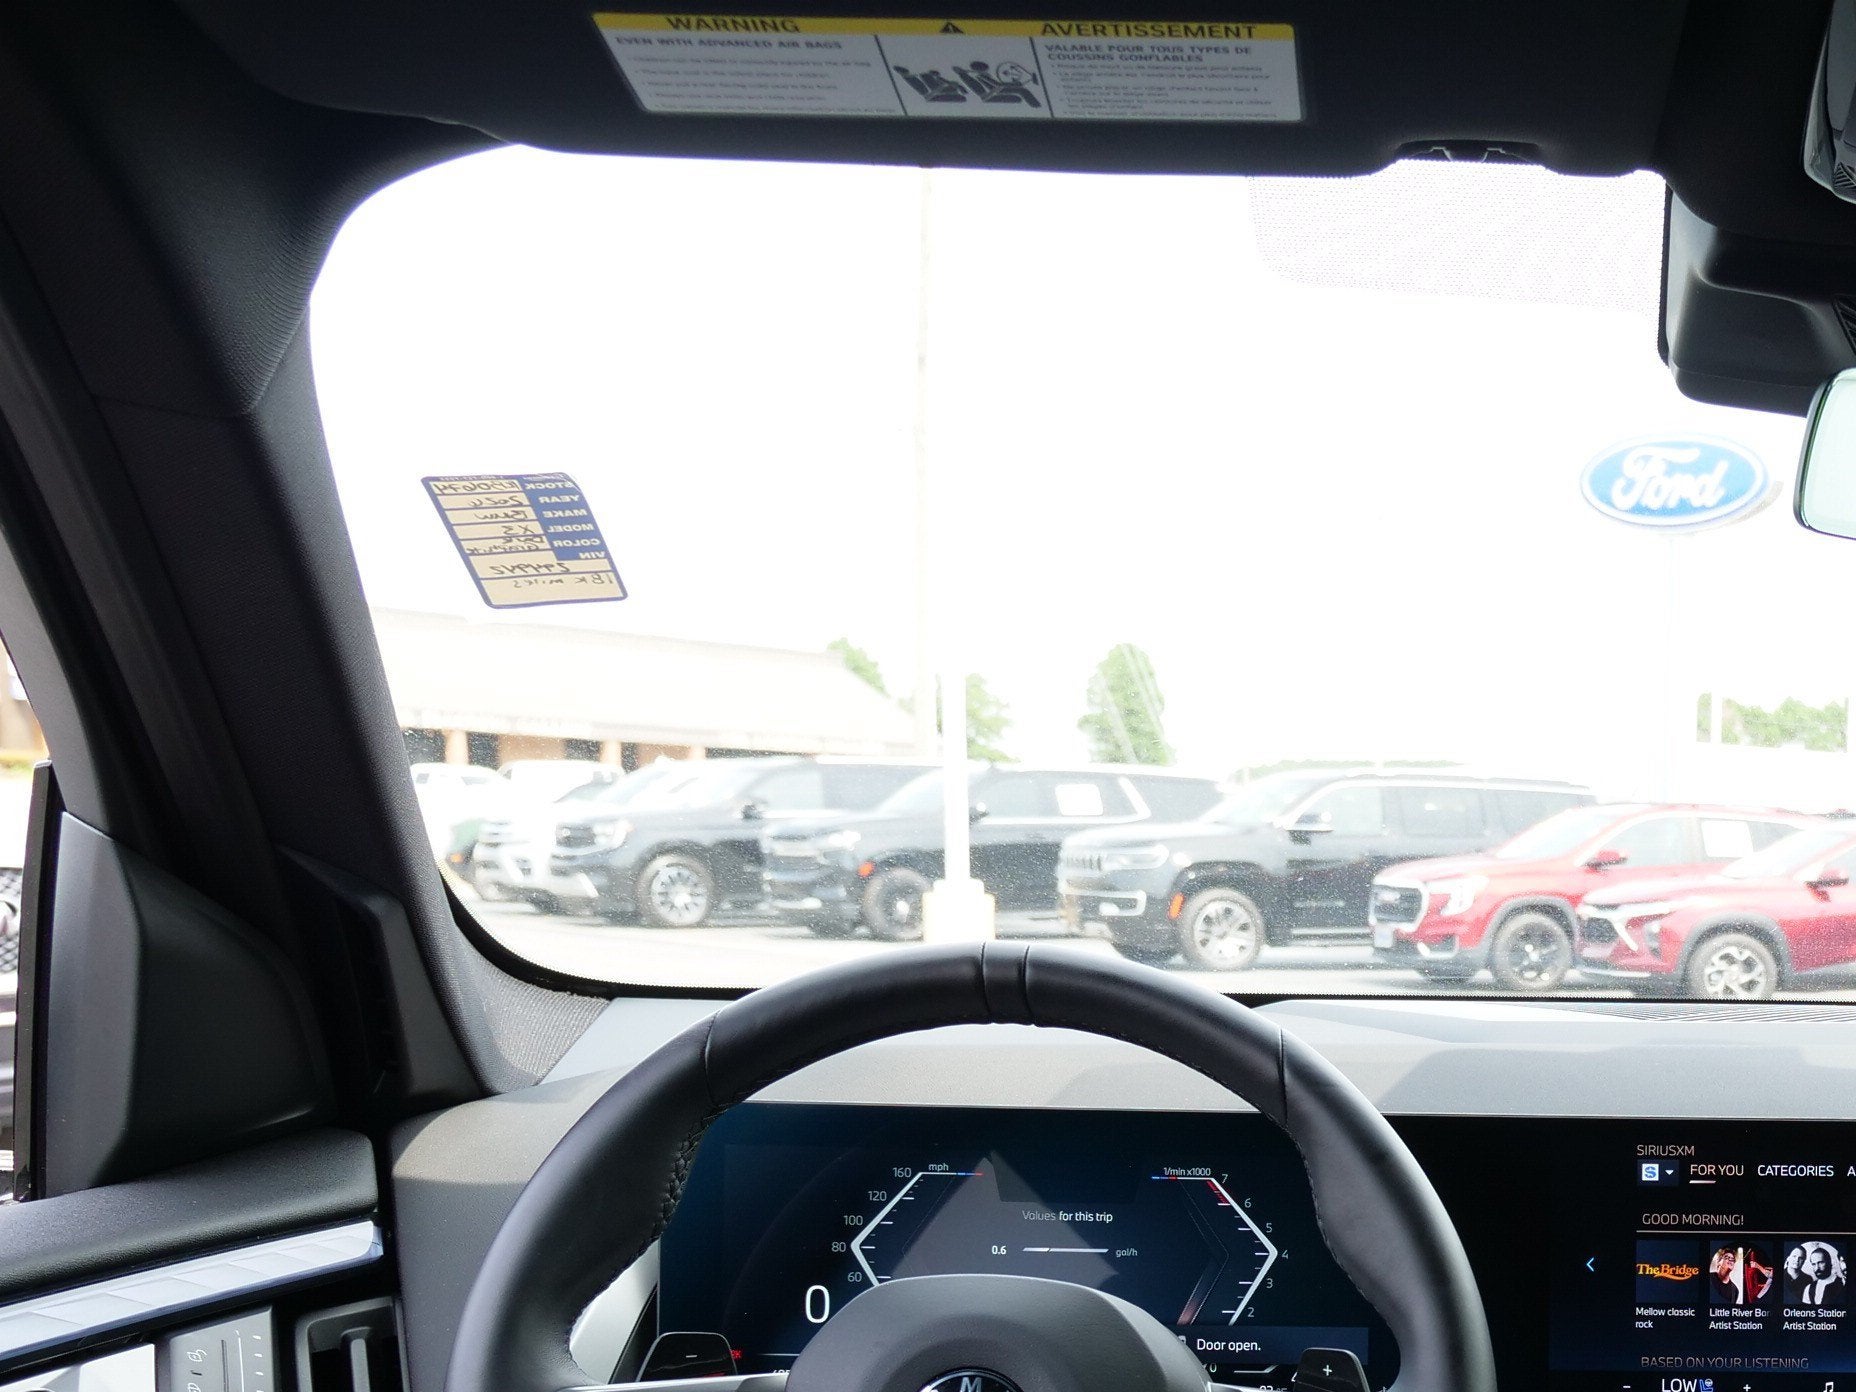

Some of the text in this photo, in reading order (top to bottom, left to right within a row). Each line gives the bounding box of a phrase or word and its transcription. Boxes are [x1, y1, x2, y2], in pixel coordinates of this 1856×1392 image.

[666, 17, 801, 33] WARNING
[1040, 22, 1257, 40] AVERTISSEMENT
[615, 36, 842, 49] EVEN WITH ADVANCED AIR BAGS
[1044, 44, 1251, 55] VALABLE POUR TOUS TYPES DE
[1048, 53, 1203, 62] COUSSINS GONFLABLES
[1610, 446, 1729, 511] Ford
[1637, 1144, 1695, 1156] SIRIUSXM
[892, 1167, 911, 1177] 160
[928, 1163, 949, 1173] mph
[1163, 1167, 1211, 1177] 1/min x1000
[1690, 1164, 1715, 1175] FOR
[1718, 1165, 1744, 1176] YOU
[1757, 1165, 1834, 1177] CATEGORIES
[1221, 1174, 1228, 1184] 7
[868, 1191, 887, 1201] 120
[1244, 1198, 1251, 1208] 6
[844, 1215, 863, 1226] 100
[1022, 1210, 1113, 1224] Values for this trip
[1642, 1213, 1744, 1226] GOOD MORNING!
[1266, 1223, 1273, 1233] 5
[831, 1242, 846, 1252] 80
[991, 1245, 1007, 1255] 0.6
[1115, 1248, 1138, 1257] gal/h
[1281, 1250, 1289, 1260] 4
[847, 1272, 862, 1282] 60
[1266, 1278, 1273, 1289] 3
[805, 1284, 830, 1323] 0
[1247, 1307, 1255, 1317] 2
[1635, 1307, 1695, 1317] Mellow classic
[1709, 1308, 1729, 1317] Little
[1731, 1308, 1753, 1317] River
[1783, 1308, 1813, 1317] Orleans
[1635, 1320, 1653, 1329] rock
[1709, 1321, 1763, 1330] Artist Station
[1783, 1322, 1837, 1331] Artist Station
[1197, 1339, 1261, 1355] Door open.
[1641, 1356, 1809, 1369] BASED ON YOUR LISTENING
[1661, 1378, 1697, 1392] LOW
